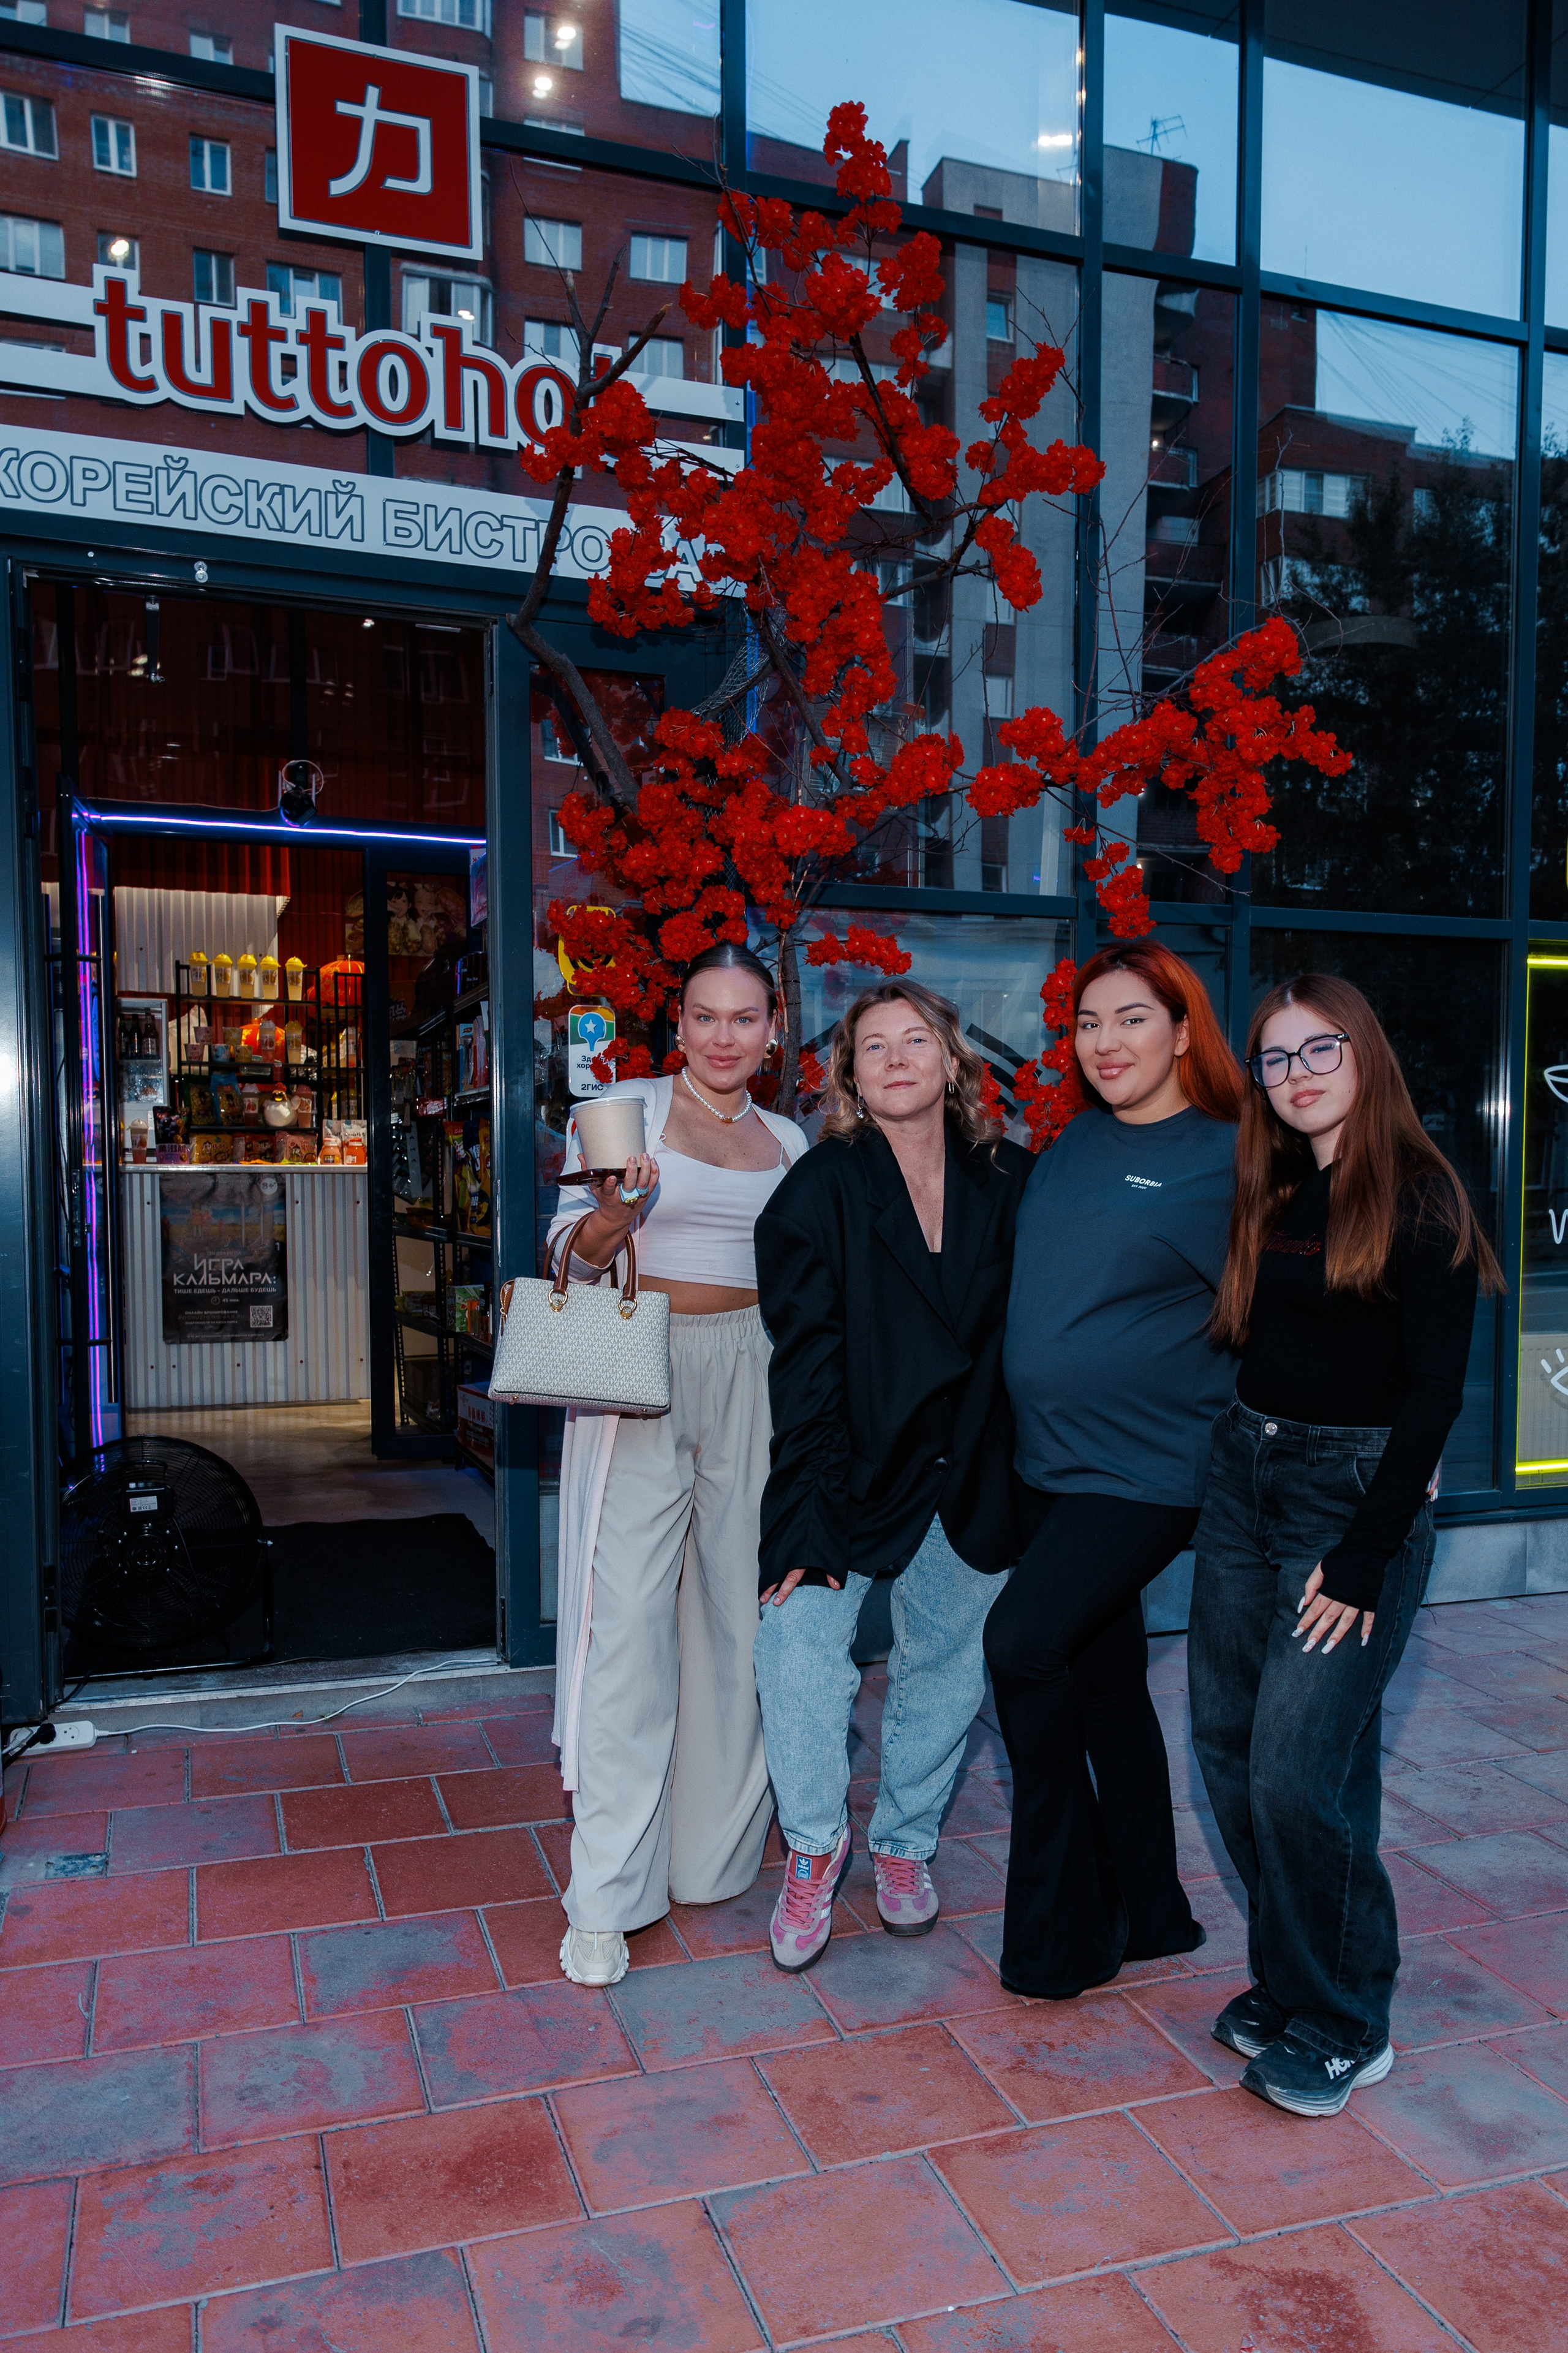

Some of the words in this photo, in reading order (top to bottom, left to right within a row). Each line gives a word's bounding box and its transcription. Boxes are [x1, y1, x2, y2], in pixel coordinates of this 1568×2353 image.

[1125, 1174, 1163, 1188] SUBORBIA
[194, 1253, 244, 1271] ИГРА
[173, 1272, 276, 1285] КАЛЬМАРА:
